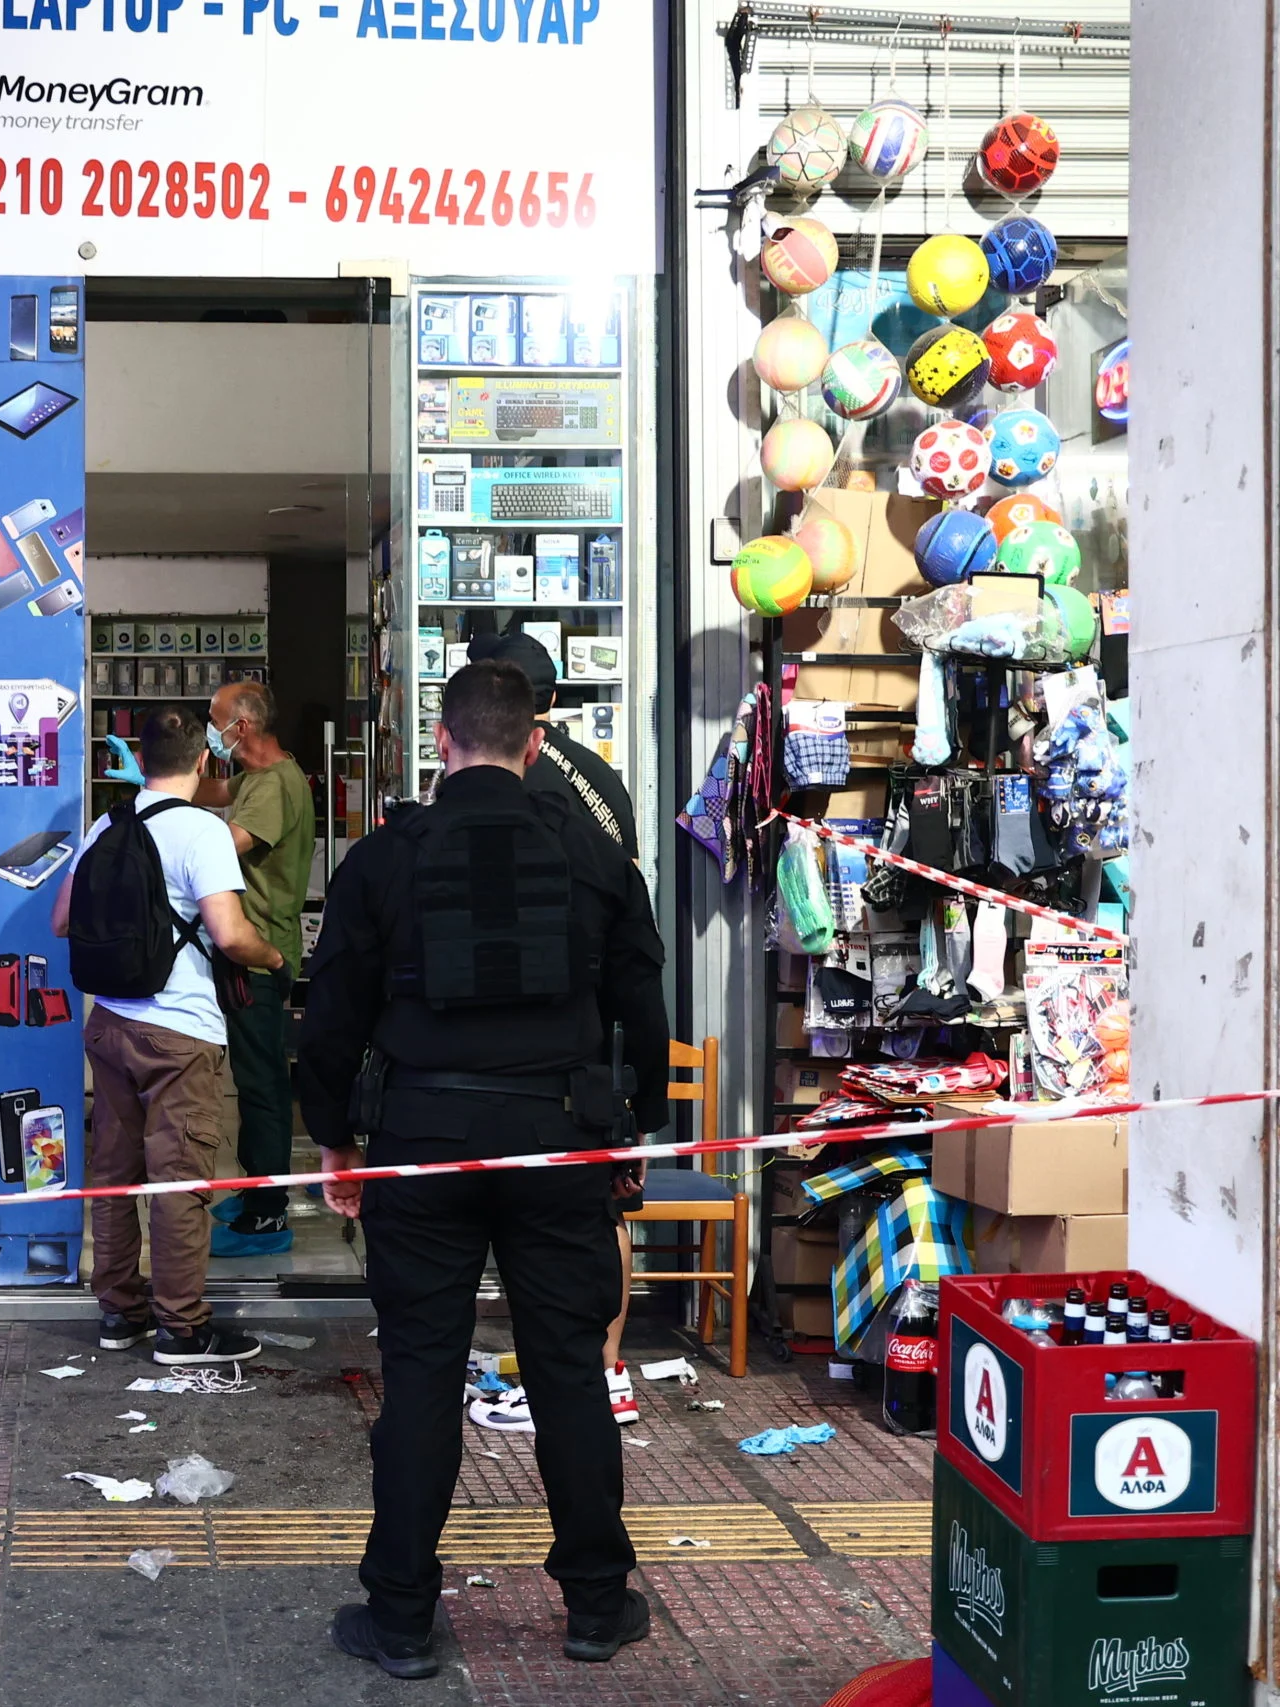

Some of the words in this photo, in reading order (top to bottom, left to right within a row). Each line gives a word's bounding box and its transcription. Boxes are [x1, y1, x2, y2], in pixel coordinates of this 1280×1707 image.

[65, 113, 143, 132] transfer
[81, 159, 271, 221] 2028502
[325, 165, 597, 229] 6942426656
[503, 471, 531, 479] OFFICE
[533, 471, 561, 479] WIRED
[920, 796, 939, 806] WHY
[974, 1415, 996, 1447] ΑΛΦΑ
[1119, 1479, 1167, 1495] ΑΛΦΑ
[948, 1519, 1006, 1622] Mythos
[1087, 1636, 1190, 1693] Mythos
